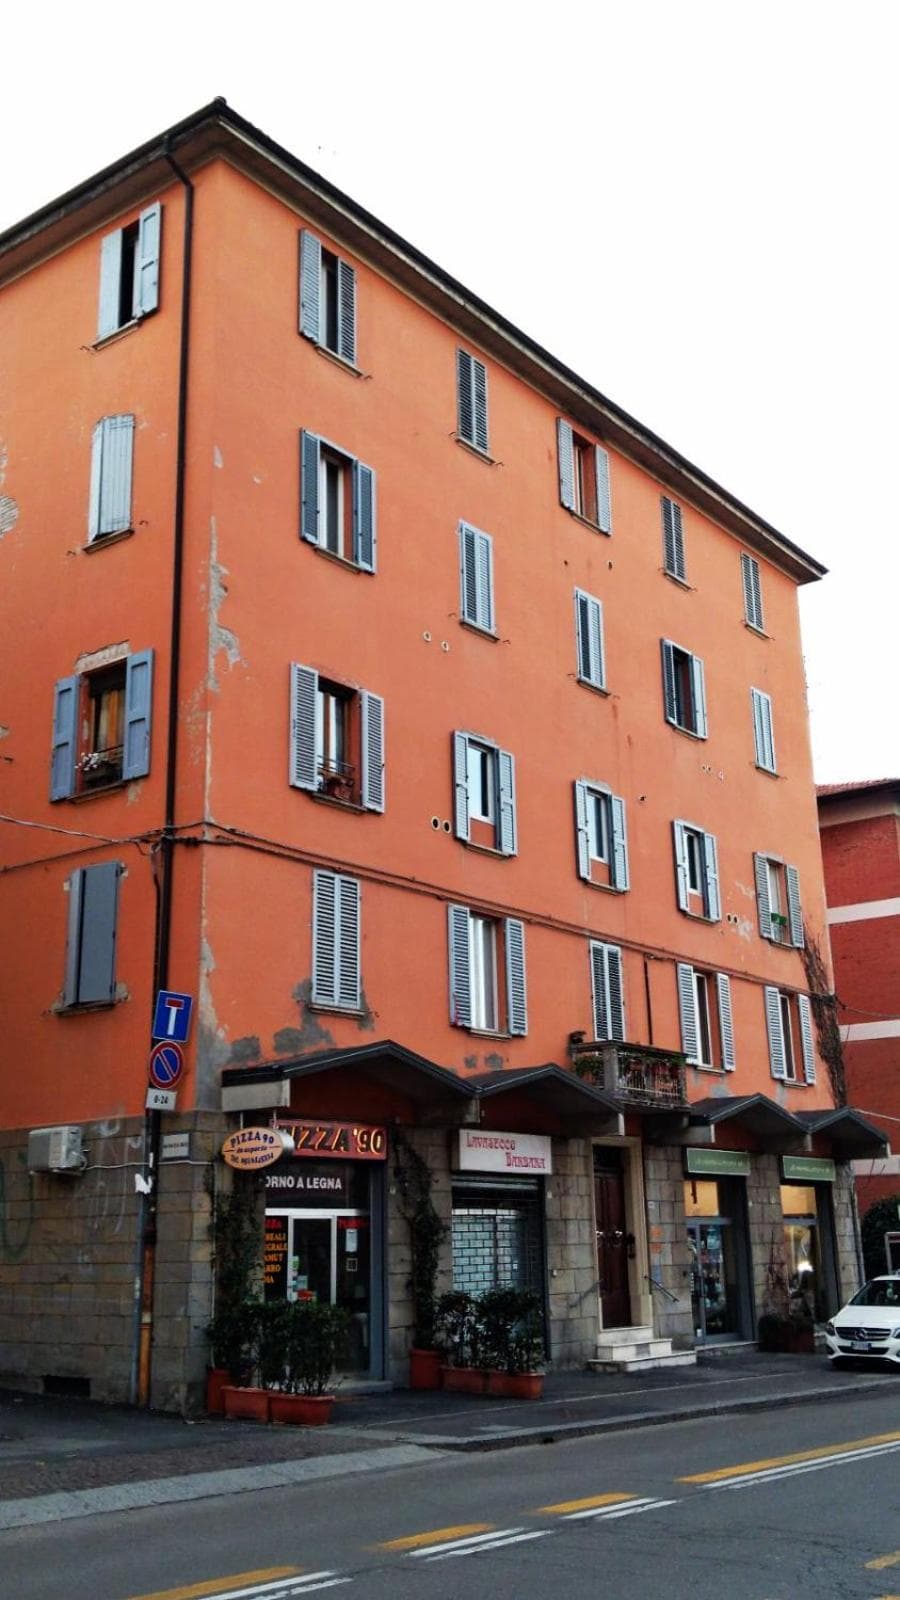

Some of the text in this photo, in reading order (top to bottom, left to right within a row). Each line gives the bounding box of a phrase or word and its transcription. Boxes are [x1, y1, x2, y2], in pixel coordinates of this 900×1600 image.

[230, 1131, 261, 1148] PIZZA
[281, 1126, 349, 1152] IZZA
[264, 1176, 342, 1190] ORNO A LEGNA
